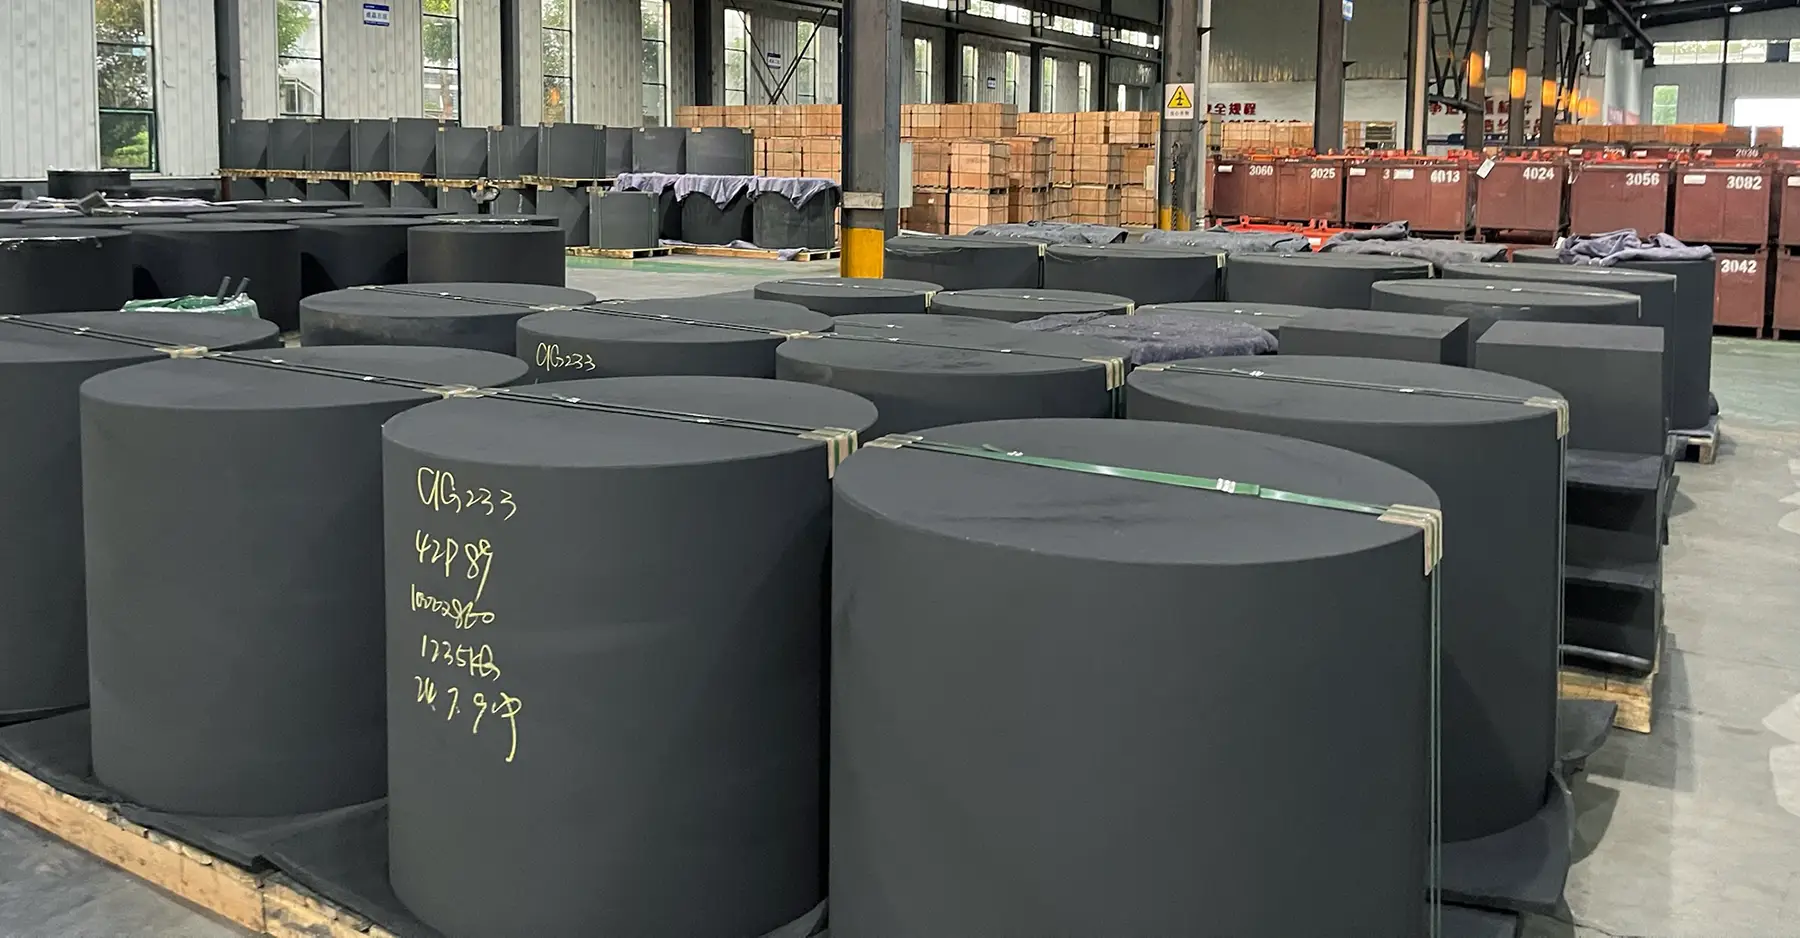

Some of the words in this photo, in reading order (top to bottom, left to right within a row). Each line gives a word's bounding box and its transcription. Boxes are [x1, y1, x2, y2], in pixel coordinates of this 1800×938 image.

[1249, 165, 1274, 176] 3060
[1310, 167, 1336, 179] 3025
[1523, 167, 1555, 180] 4024
[1626, 172, 1661, 186] 3056
[1726, 175, 1763, 190] 3082
[1720, 259, 1757, 273] 3042
